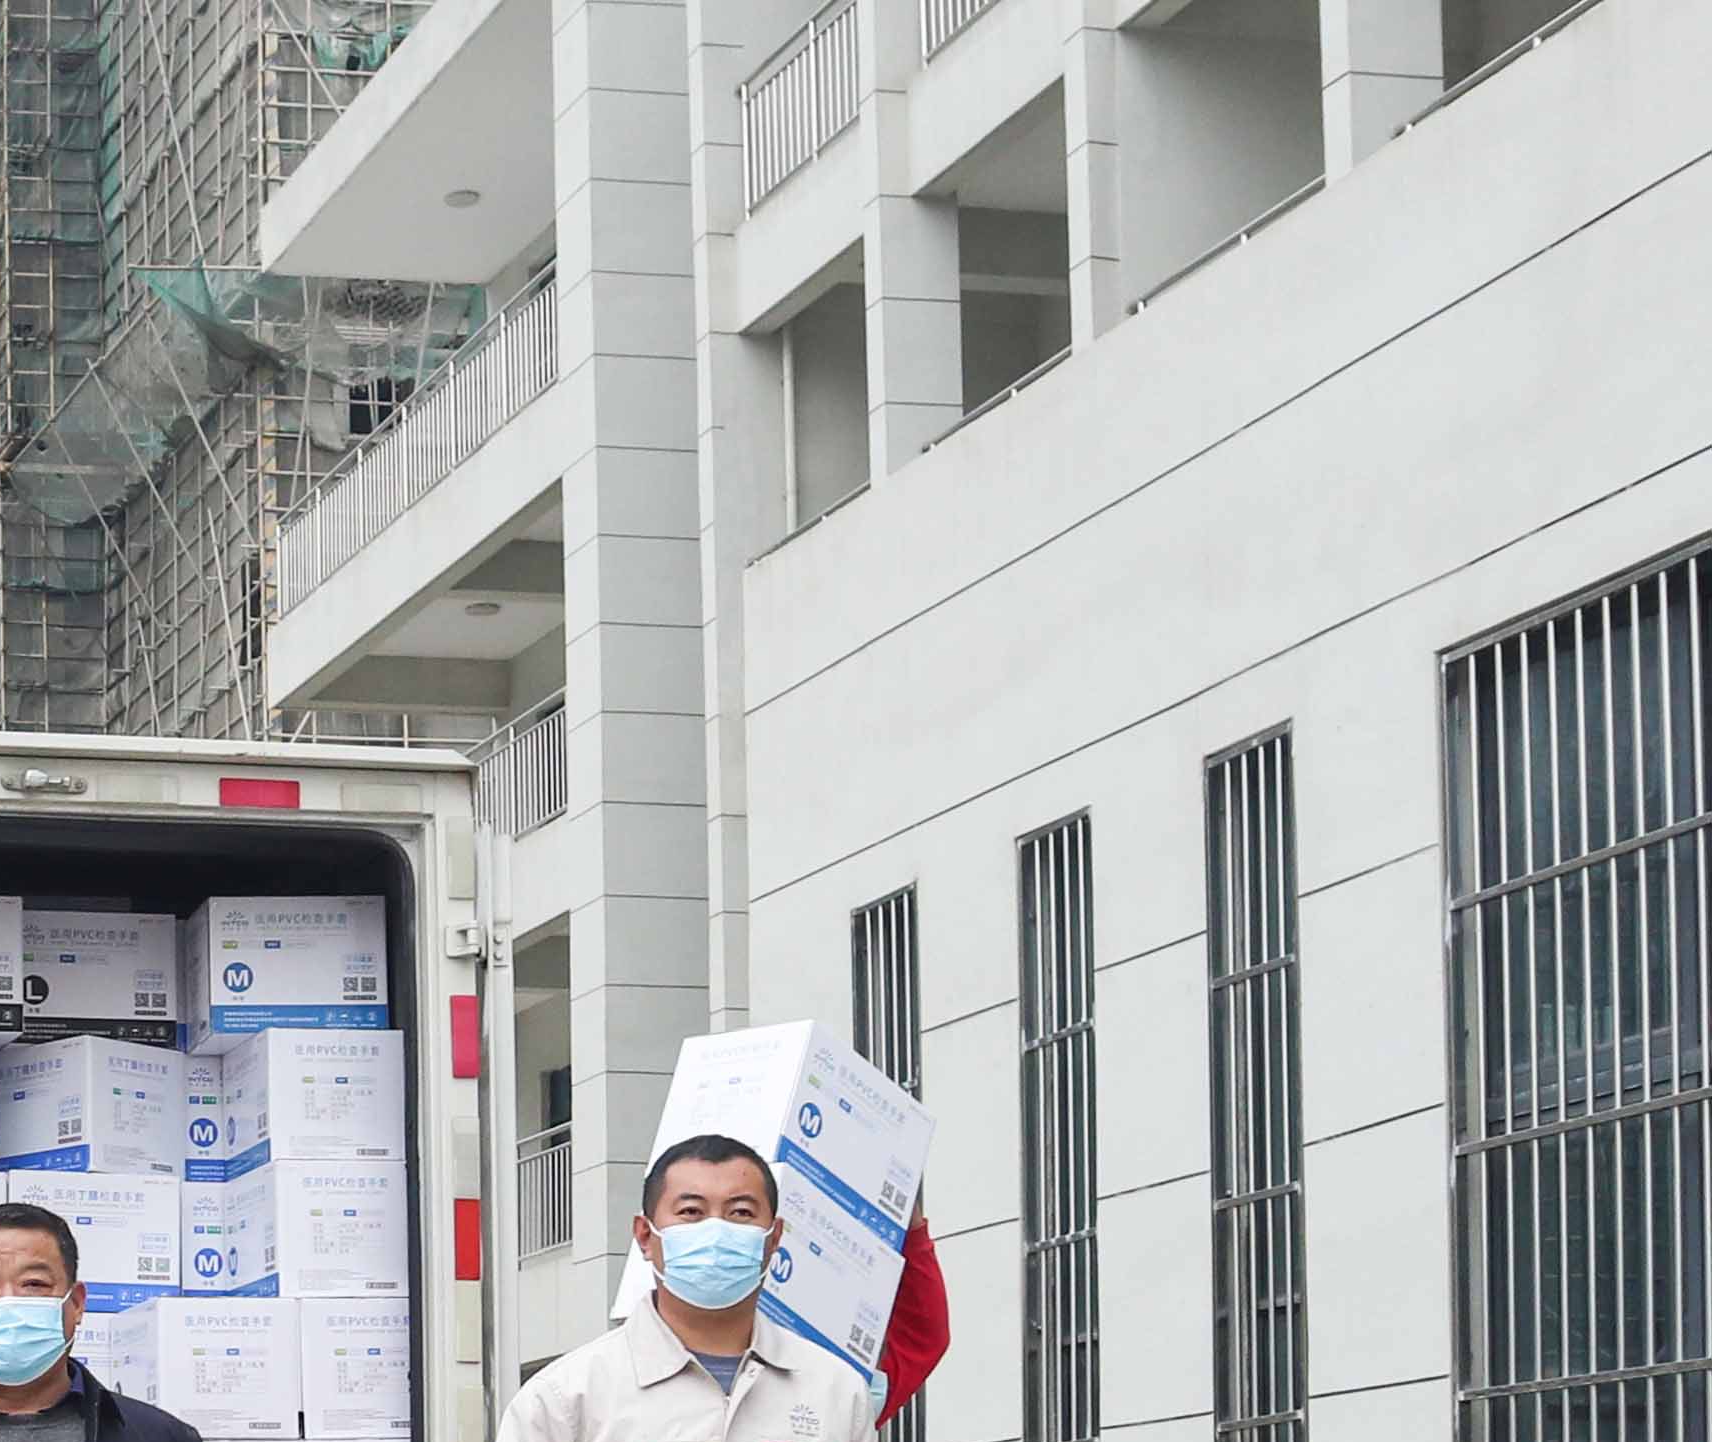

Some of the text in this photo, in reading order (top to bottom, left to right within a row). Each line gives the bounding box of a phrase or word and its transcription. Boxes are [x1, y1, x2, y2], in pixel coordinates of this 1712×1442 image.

[227, 969, 248, 987] M
[26, 979, 43, 1000] L
[800, 1106, 821, 1135] M
[193, 1125, 214, 1141] M
[198, 1255, 220, 1273] M
